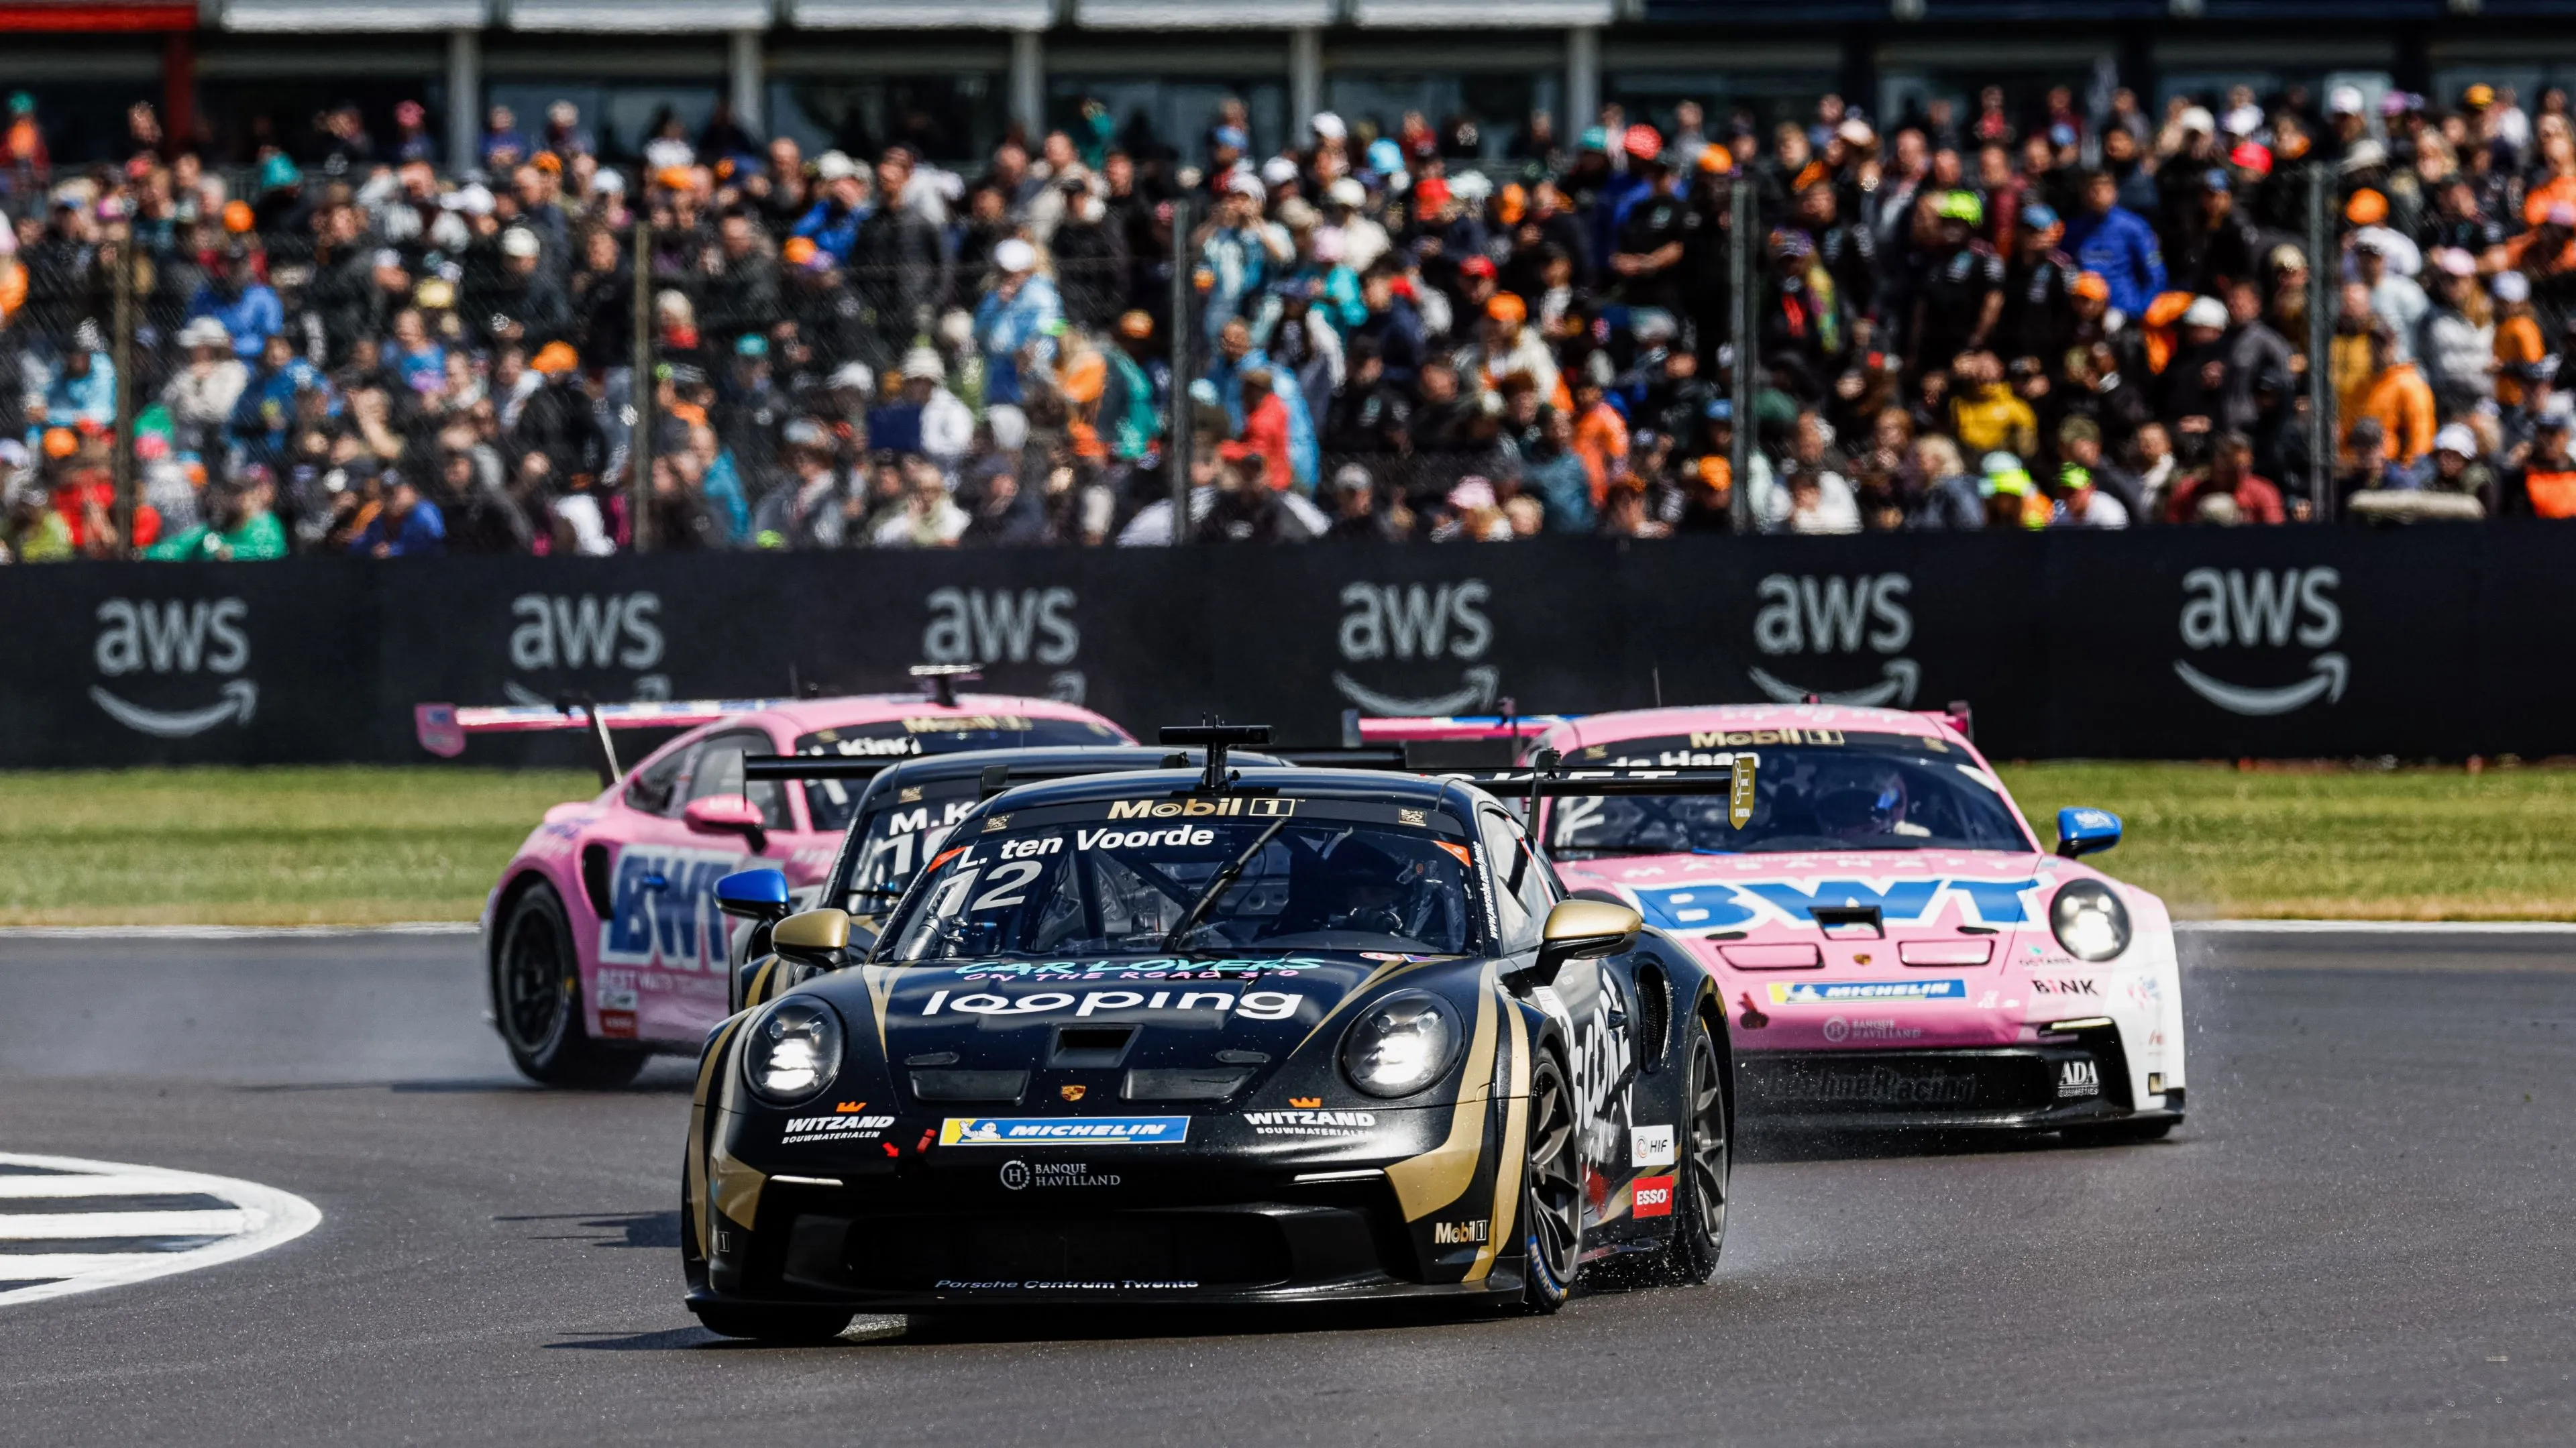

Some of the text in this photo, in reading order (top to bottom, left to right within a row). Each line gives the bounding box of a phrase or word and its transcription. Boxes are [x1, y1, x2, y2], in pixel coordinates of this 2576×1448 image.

[1756, 575, 1910, 652] aws
[2182, 569, 2339, 645] aws
[924, 589, 1079, 664] aws
[1340, 582, 1489, 659] aws
[97, 600, 248, 673] aws
[512, 594, 663, 669] aws
[1690, 728, 1801, 748] Mobil
[1107, 798, 1242, 820] Mobil
[957, 824, 1214, 869] L. ten Voorde
[938, 860, 1042, 918] 12
[1622, 875, 2045, 932] BWT
[955, 958, 1326, 975] CAR LOVERS
[963, 973, 1016, 981] ON
[1036, 972, 1105, 981] THE
[1120, 970, 1221, 979] ROAD
[1825, 983, 1951, 997] MICHELIN
[922, 990, 1303, 1020] looping
[2059, 1060, 2099, 1085] ADA
[785, 1116, 896, 1133] WITZAND
[1244, 1111, 1376, 1127] WITZAND
[781, 1130, 881, 1145] BOUWMATERIALEN
[1008, 1123, 1167, 1137] MICHELIN
[1650, 1139, 1668, 1154] HIF
[1035, 1162, 1087, 1176] BANQUE
[1035, 1174, 1121, 1186] HAVILLAND
[1636, 1188, 1667, 1206] ESSO
[1435, 1221, 1476, 1244] Mobil
[934, 1280, 1018, 1288] Porsche
[1023, 1280, 1116, 1289] Centrum
